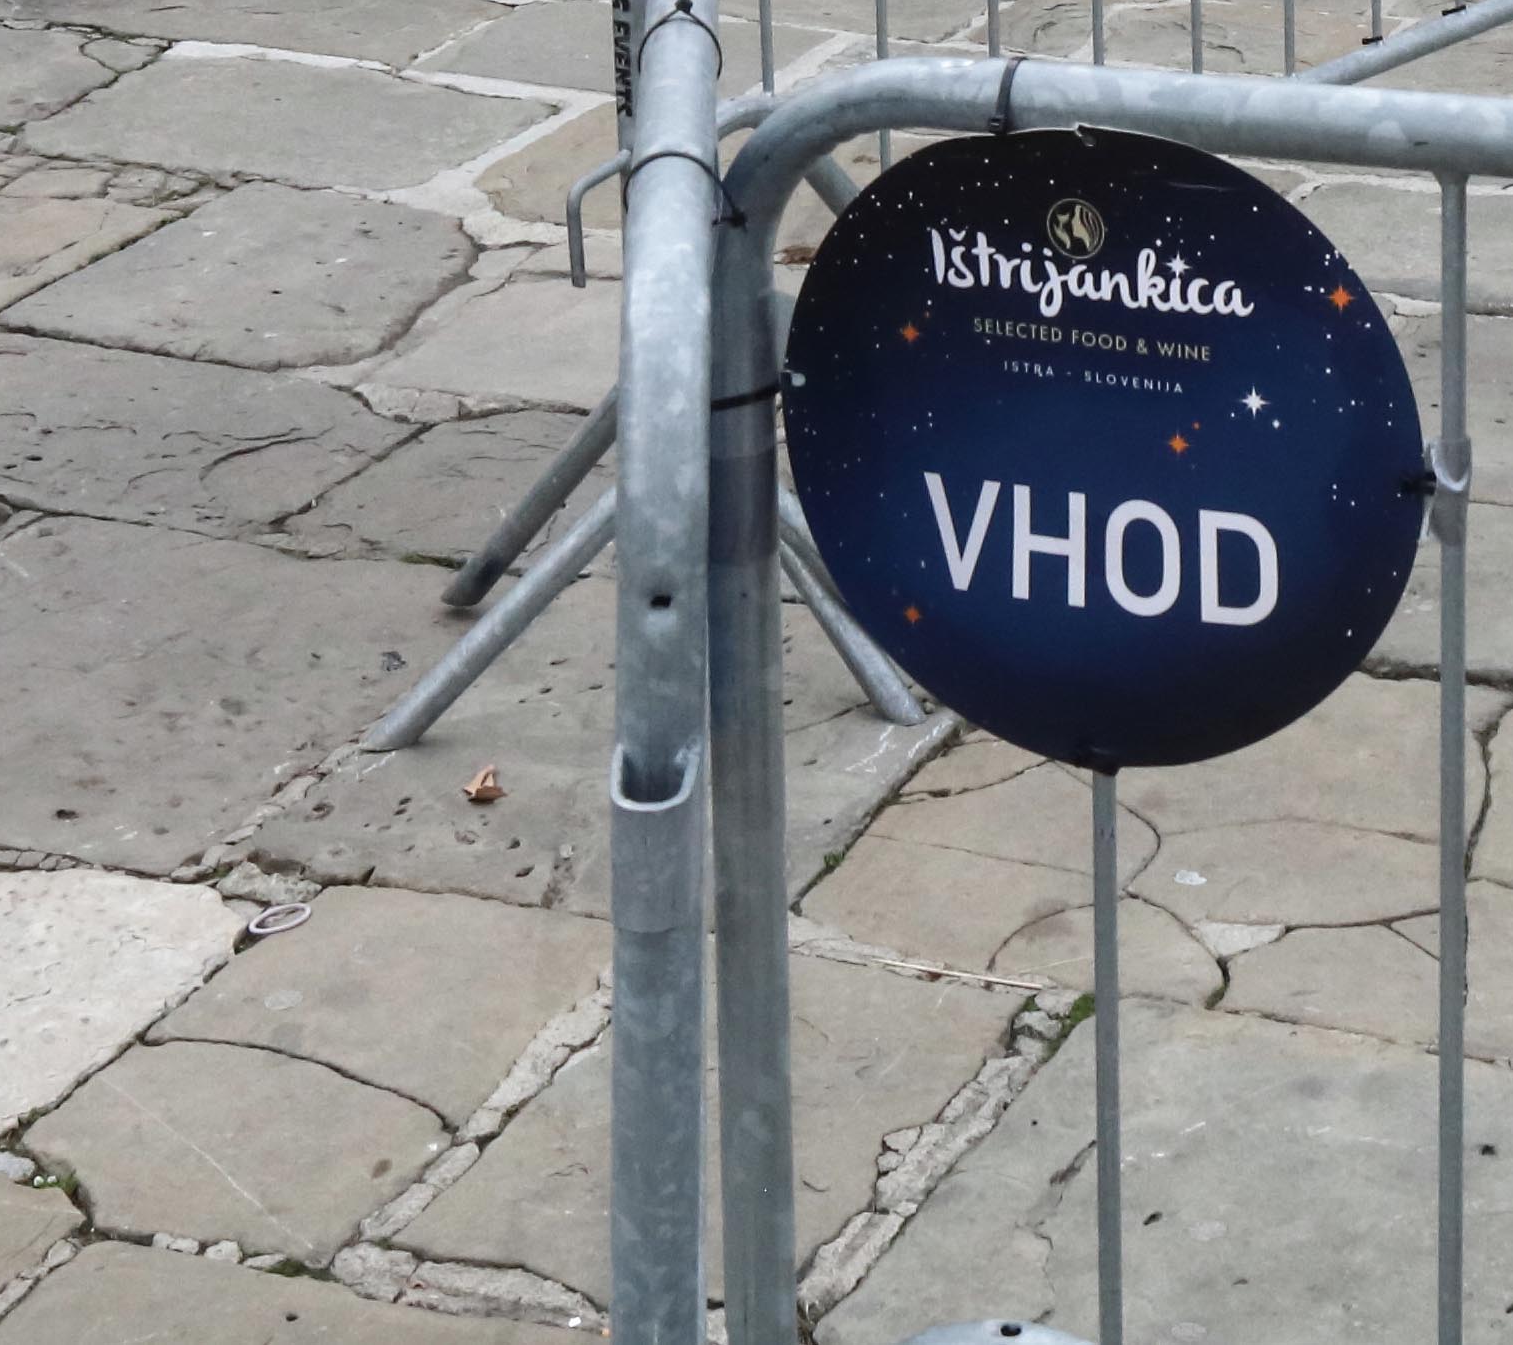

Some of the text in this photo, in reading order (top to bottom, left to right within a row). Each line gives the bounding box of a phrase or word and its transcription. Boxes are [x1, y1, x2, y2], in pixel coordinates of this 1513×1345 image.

[930, 227, 1255, 318] Ištrijankica
[973, 317, 1212, 362] SELECTED FOOD & WINE
[1003, 360, 1055, 378] ISTRA
[1083, 370, 1184, 394] SLOVENIJA
[923, 470, 1280, 627] VHOD
